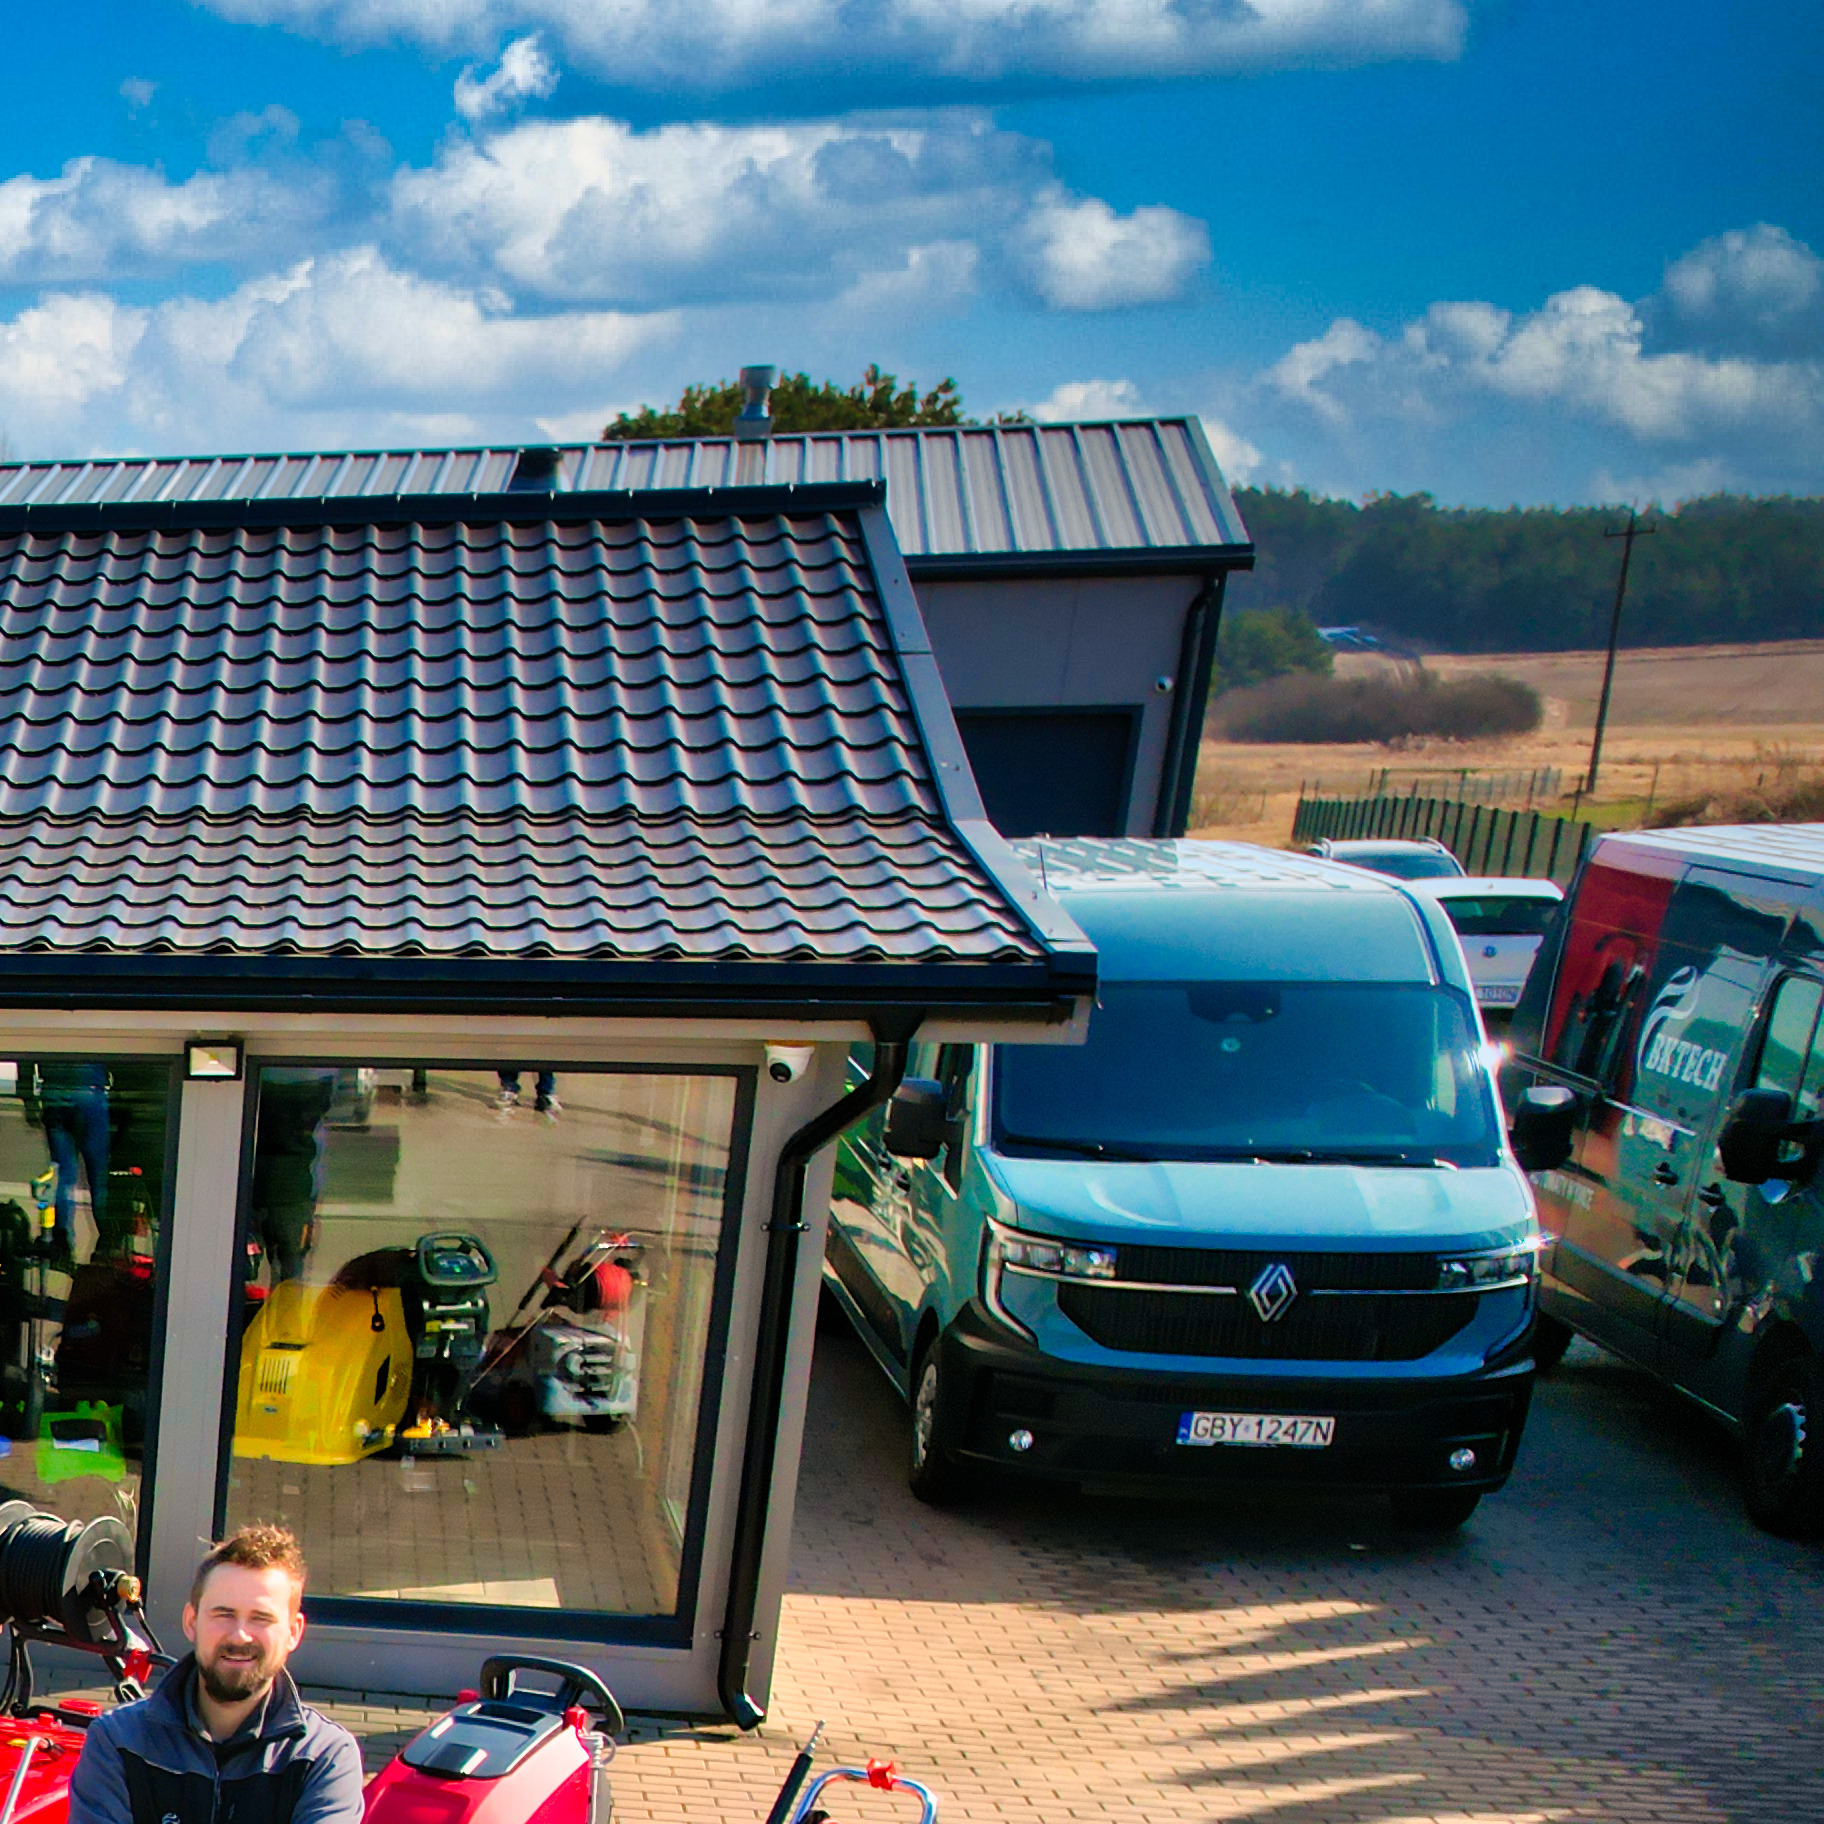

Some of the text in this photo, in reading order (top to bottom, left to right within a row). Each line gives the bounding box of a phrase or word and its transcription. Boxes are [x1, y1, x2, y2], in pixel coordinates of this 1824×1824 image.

[1646, 1032, 1728, 1092] BKTECH
[1193, 1416, 1332, 1443] GBY 1247N
